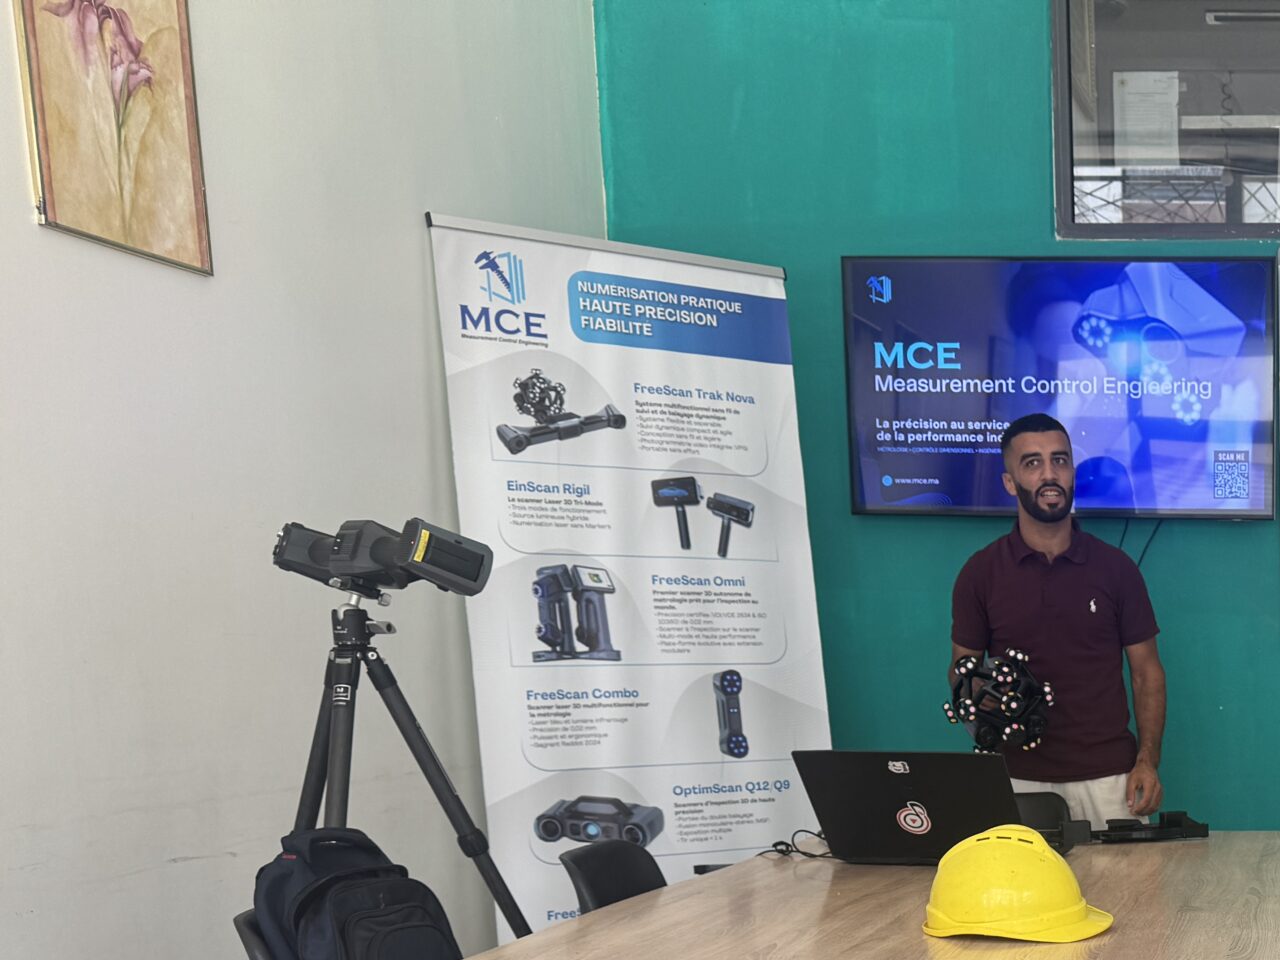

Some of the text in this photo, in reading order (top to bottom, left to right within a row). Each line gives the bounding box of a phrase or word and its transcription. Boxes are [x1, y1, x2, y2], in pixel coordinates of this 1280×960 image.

[579, 297, 632, 316] HAUTE
[681, 294, 743, 314] PRATIQUE
[458, 304, 548, 339] MCE
[874, 342, 961, 370] MCE
[874, 374, 1015, 393] Measurement
[1021, 375, 1098, 394] Control
[633, 383, 755, 404] FreeScan Trak Nova
[875, 418, 1010, 431] La précision au service
[876, 431, 891, 441] de
[894, 431, 905, 441] la
[907, 431, 984, 444] performance
[1218, 453, 1235, 461] SCAN
[507, 480, 590, 498] EinScan Rigil
[894, 477, 940, 485] www.mce.ma
[651, 575, 746, 587] FreeScan Omni
[526, 688, 639, 700] FreeScan Combo
[673, 783, 743, 797] OptimScan
